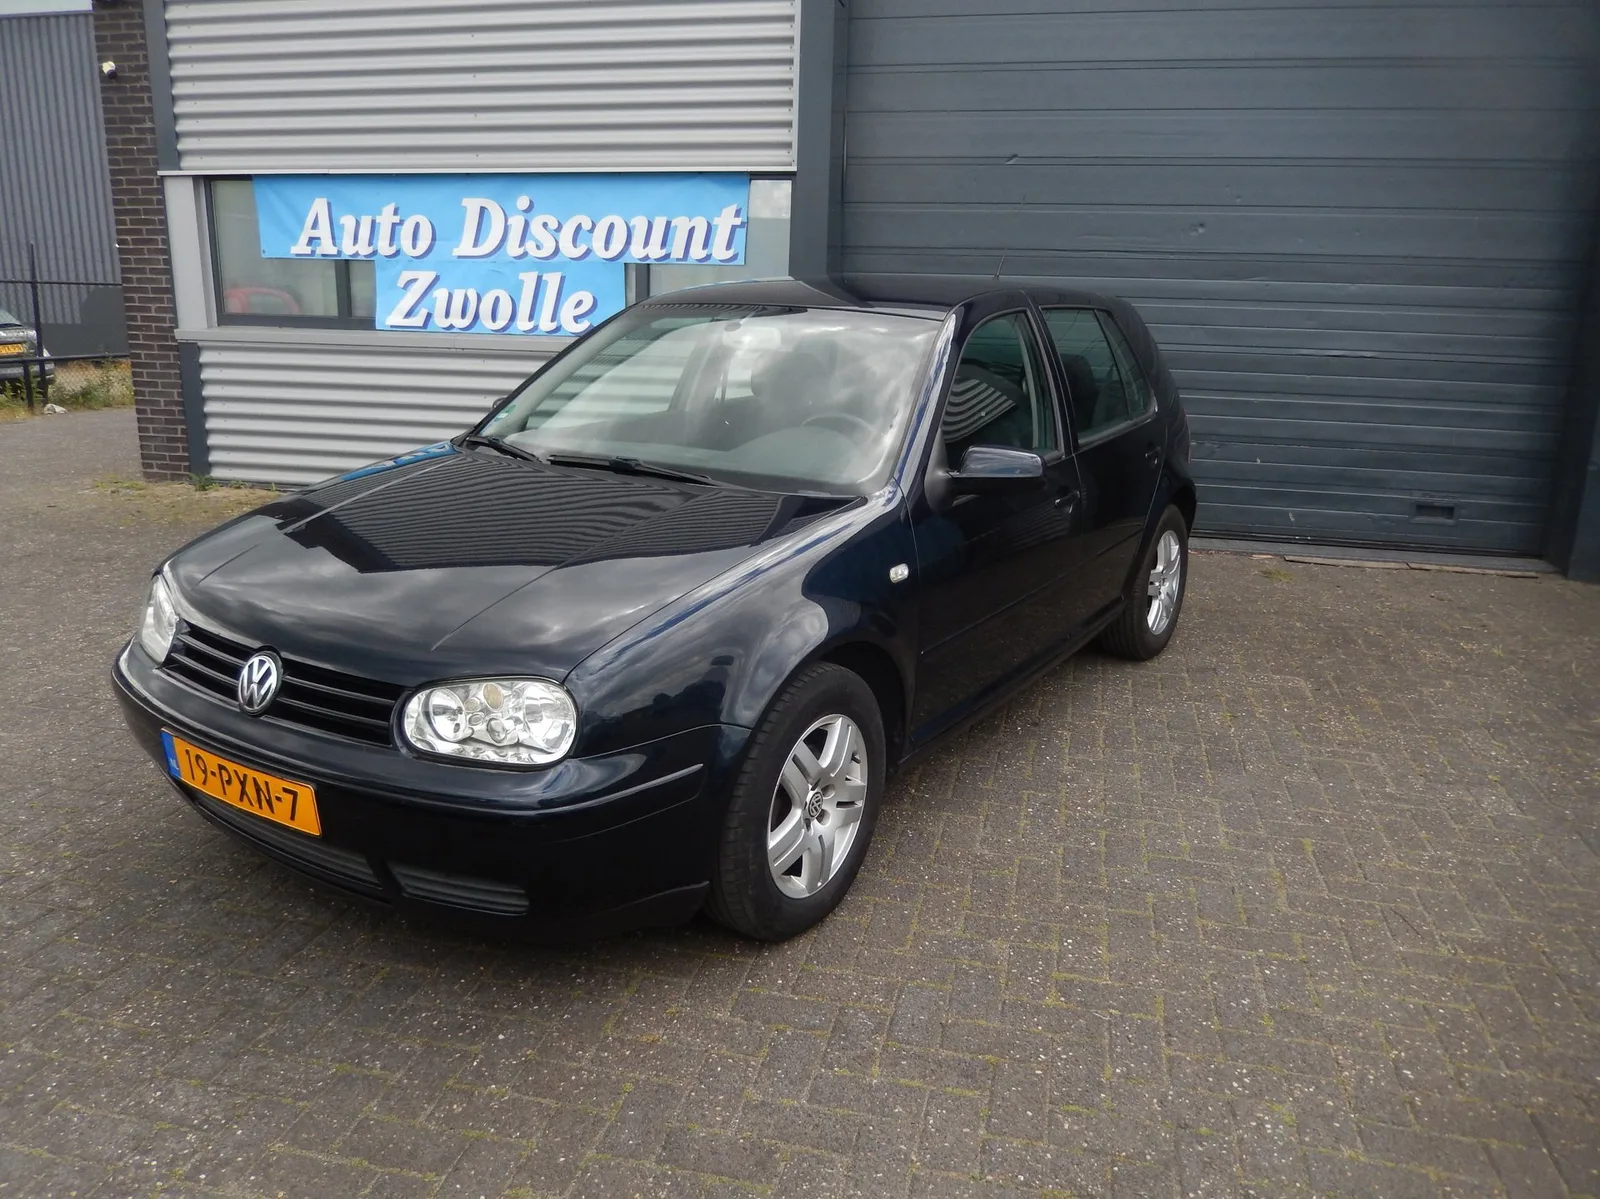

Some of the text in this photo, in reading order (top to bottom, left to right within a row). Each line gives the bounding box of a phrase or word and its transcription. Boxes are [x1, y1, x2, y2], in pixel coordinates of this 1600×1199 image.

[291, 195, 746, 263] Auto Discount
[385, 270, 597, 333] Zwolle
[185, 748, 299, 822] 19-PXN-7
